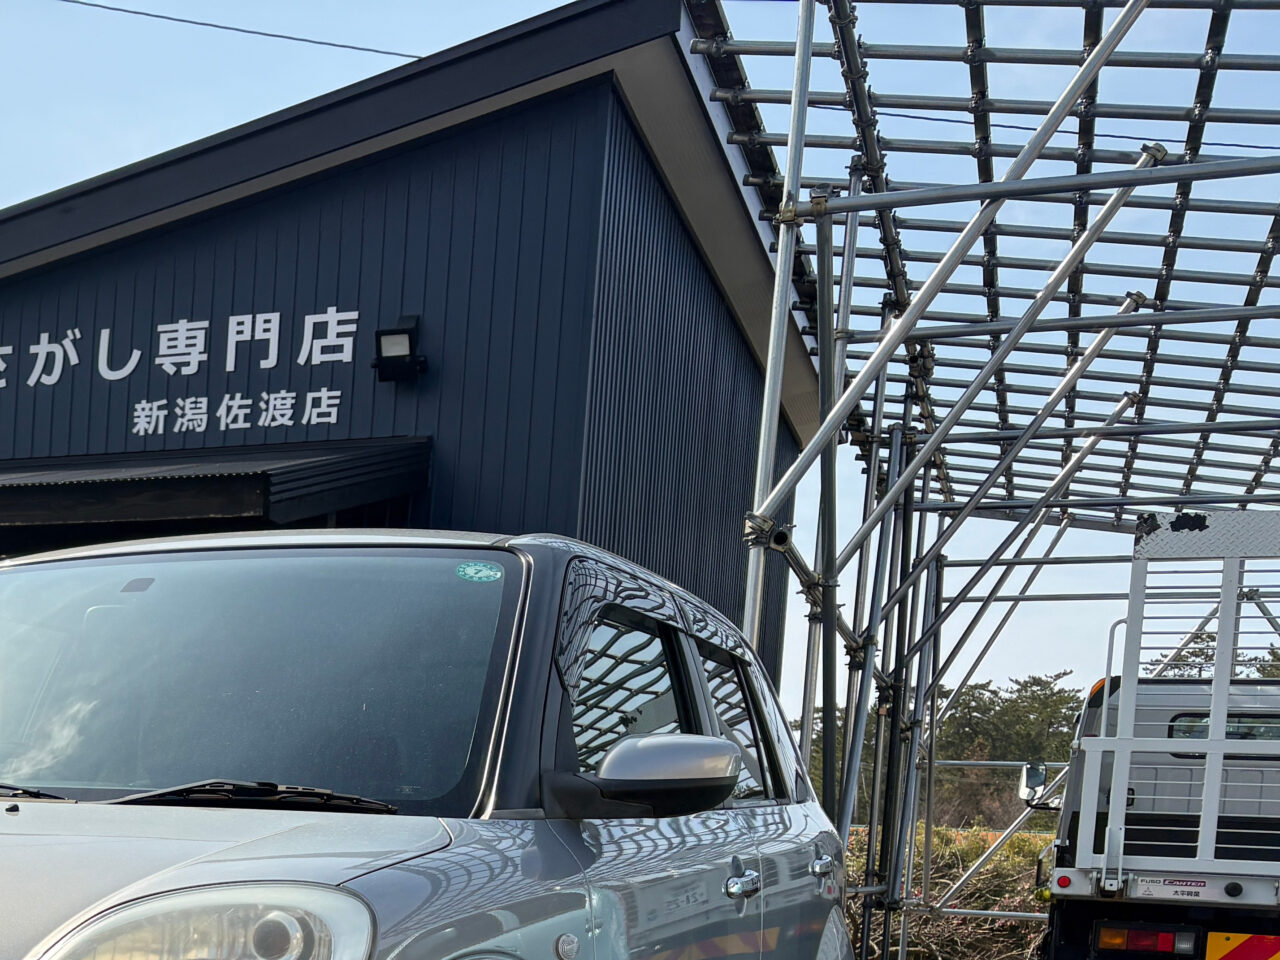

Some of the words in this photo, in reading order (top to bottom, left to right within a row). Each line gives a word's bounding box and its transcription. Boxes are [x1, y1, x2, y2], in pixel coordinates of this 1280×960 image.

[132, 387, 342, 436] 新潟佐渡店
